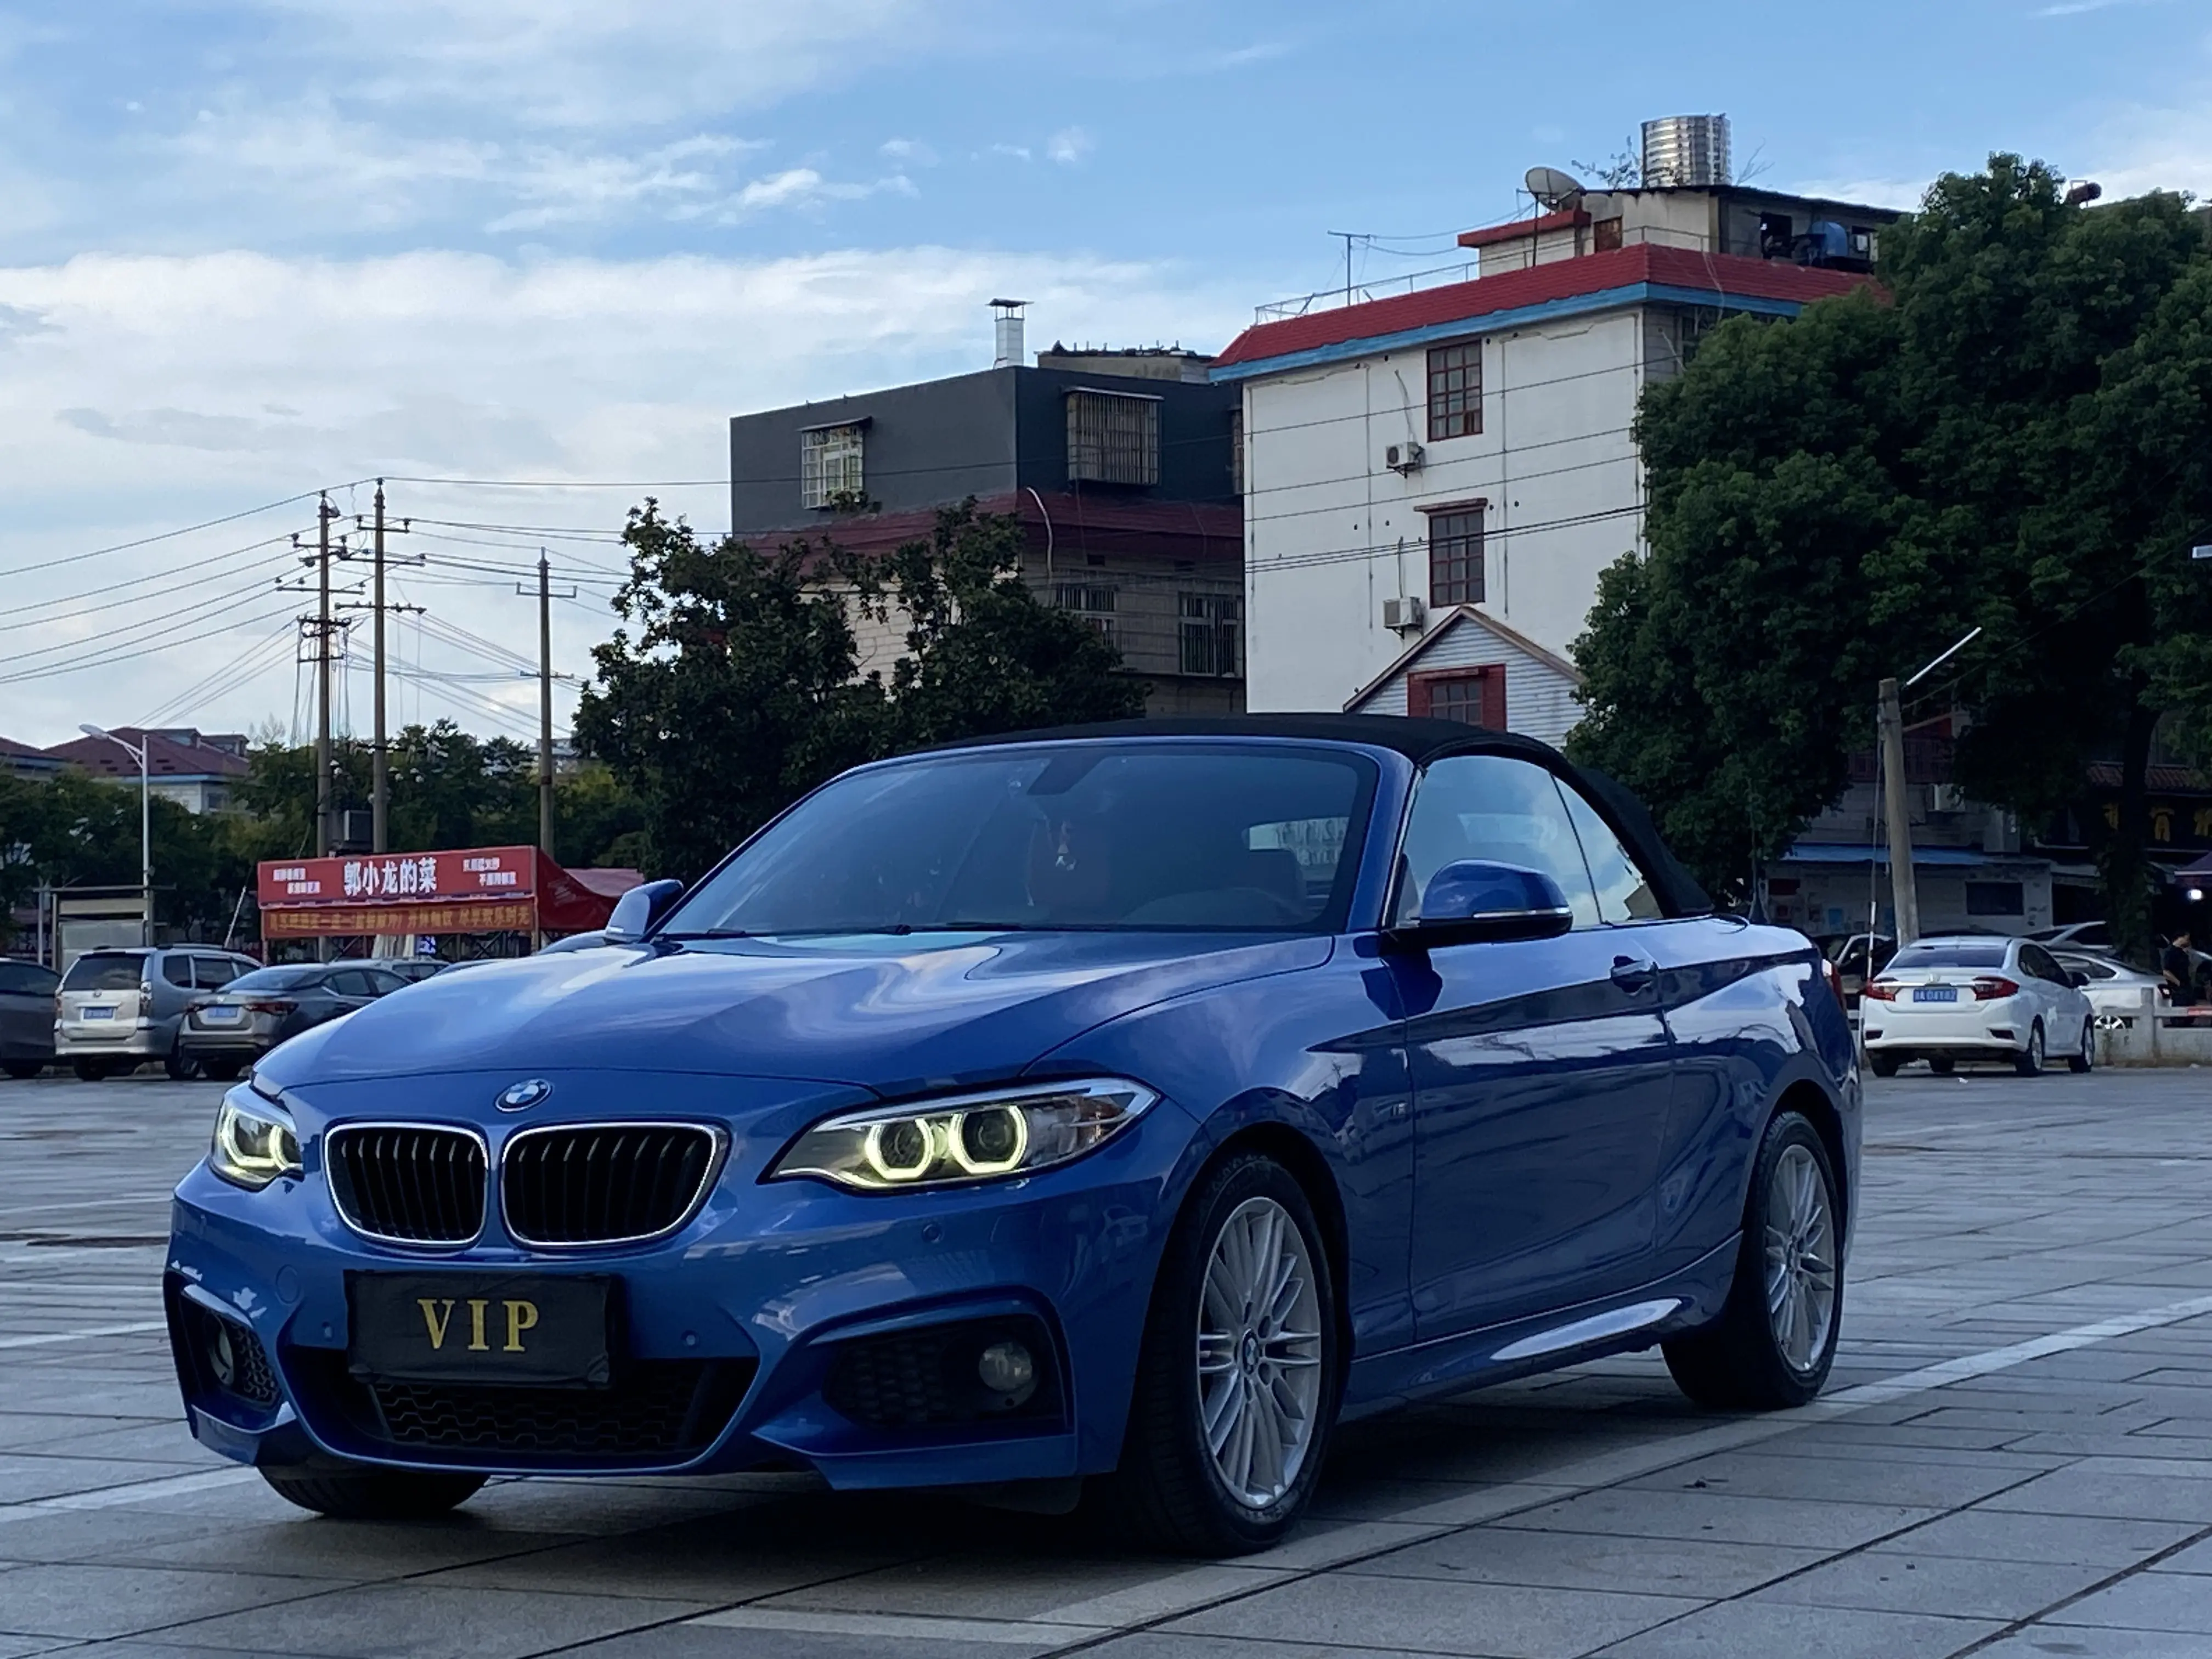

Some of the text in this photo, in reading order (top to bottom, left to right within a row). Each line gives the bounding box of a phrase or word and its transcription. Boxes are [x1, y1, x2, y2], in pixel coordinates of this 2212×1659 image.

[344, 857, 437, 896] 郭小龙的菜
[416, 1299, 539, 1351] VIP
